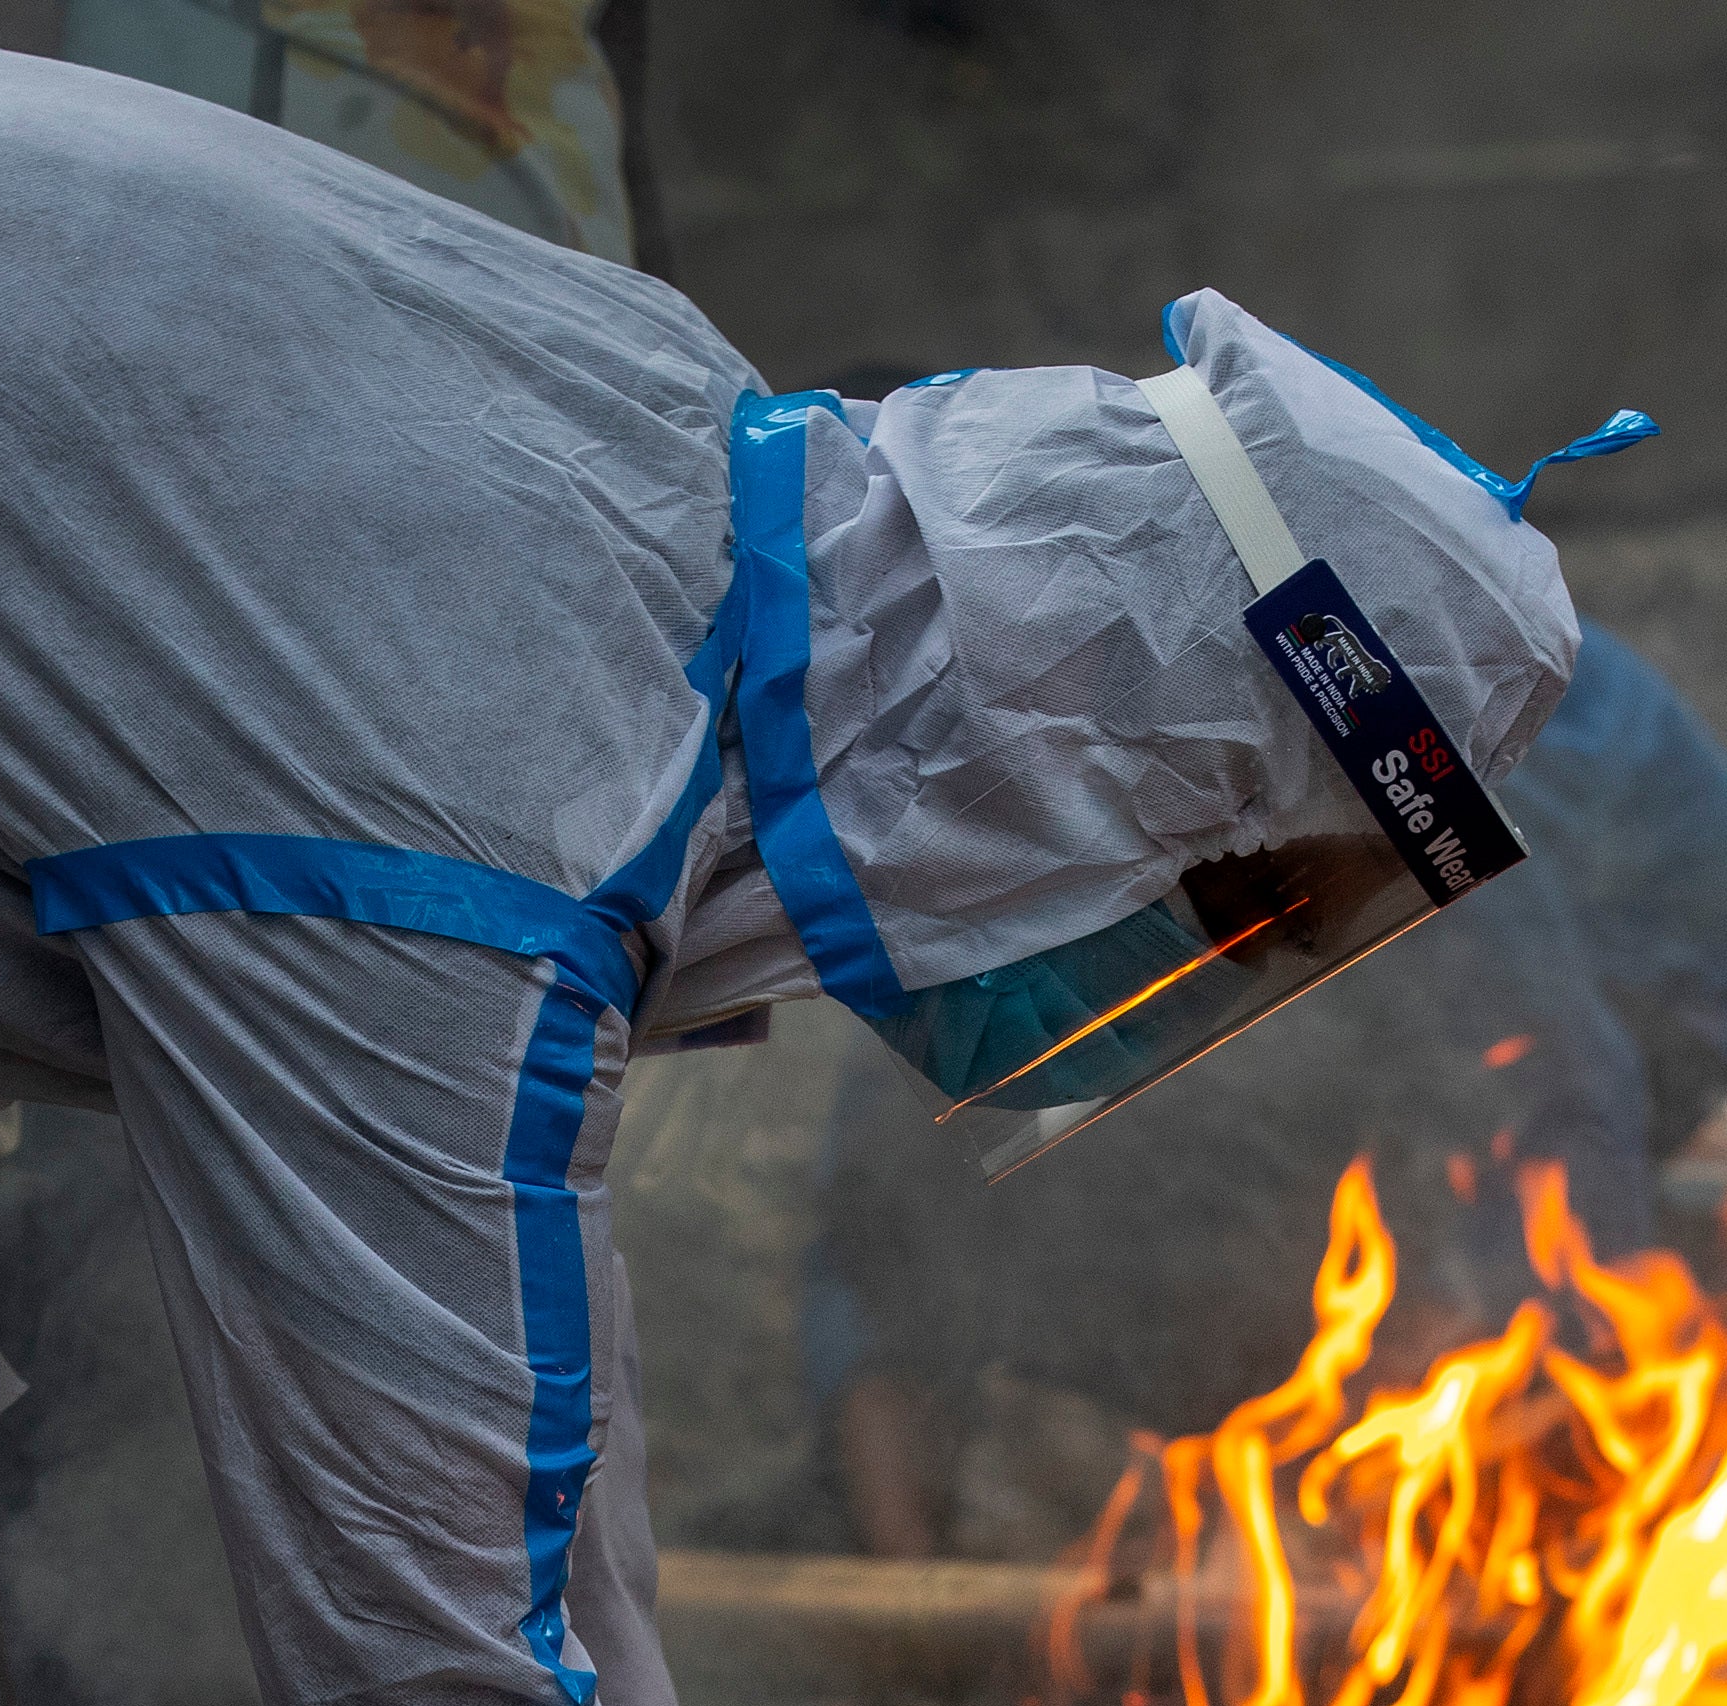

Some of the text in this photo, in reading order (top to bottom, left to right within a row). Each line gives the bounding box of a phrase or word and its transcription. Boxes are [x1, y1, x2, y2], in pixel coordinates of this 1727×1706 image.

[1275, 631, 1351, 737] WITH PRIDE & PRECISION
[1300, 646, 1324, 675] MADE
[1318, 672, 1331, 685] IN
[1338, 636, 1375, 684] MAKE IN INDIA
[1408, 727, 1456, 783] SSI
[1371, 749, 1435, 834] Safe
